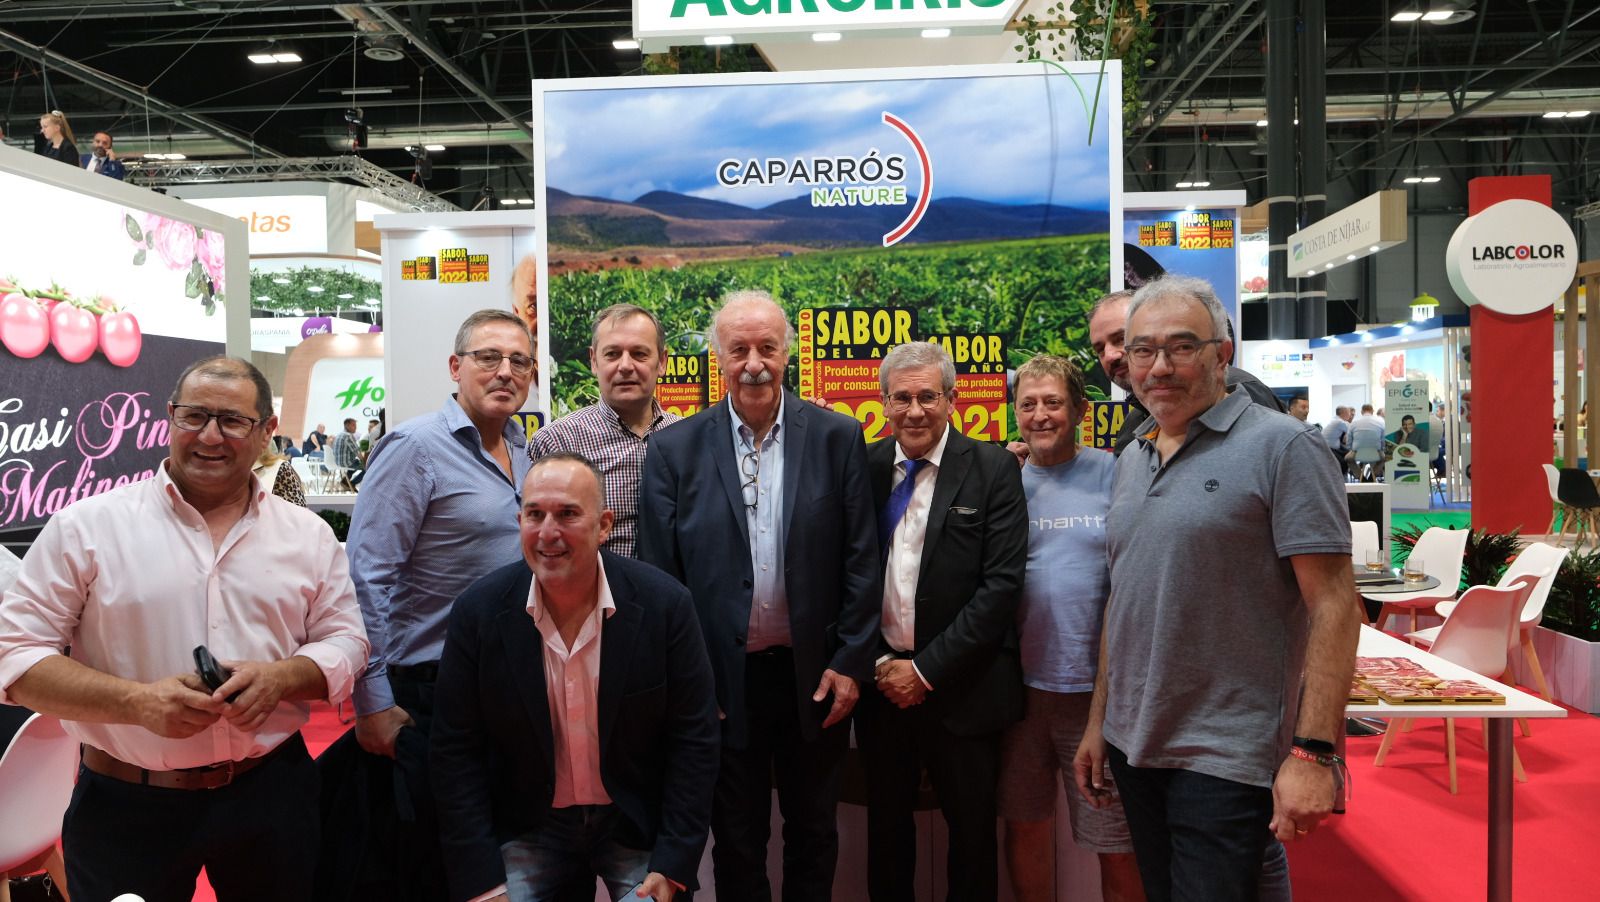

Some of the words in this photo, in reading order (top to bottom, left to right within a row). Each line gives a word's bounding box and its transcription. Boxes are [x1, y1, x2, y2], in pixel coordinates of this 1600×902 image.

[718, 151, 905, 186] CAPARRÓS
[813, 188, 906, 205] NATURE
[1180, 237, 1211, 250] 2022
[1304, 234, 1327, 255] COSTA
[1328, 229, 1337, 247] DE
[442, 248, 467, 259] SABOR
[1472, 244, 1565, 261] LABCOLOR
[1513, 262, 1566, 271] Agroalimentario
[439, 271, 468, 283] 2022
[816, 309, 912, 346] SABOR
[800, 312, 812, 398] APROBADO
[816, 348, 854, 359] DEL
[665, 356, 703, 376] ABO
[710, 344, 718, 400] APROBAD
[824, 365, 869, 376] Producto
[969, 362, 1004, 373] AÑO
[686, 375, 702, 383] AÑ
[970, 378, 1003, 389] probado
[684, 387, 701, 395] proba
[825, 383, 841, 393] por
[843, 381, 880, 391] consum
[957, 389, 1003, 399] nsumidores
[75, 392, 171, 460] Pin
[1083, 406, 1093, 442] BADO
[1096, 437, 1117, 447] DE
[1028, 514, 1103, 531] rhartt
